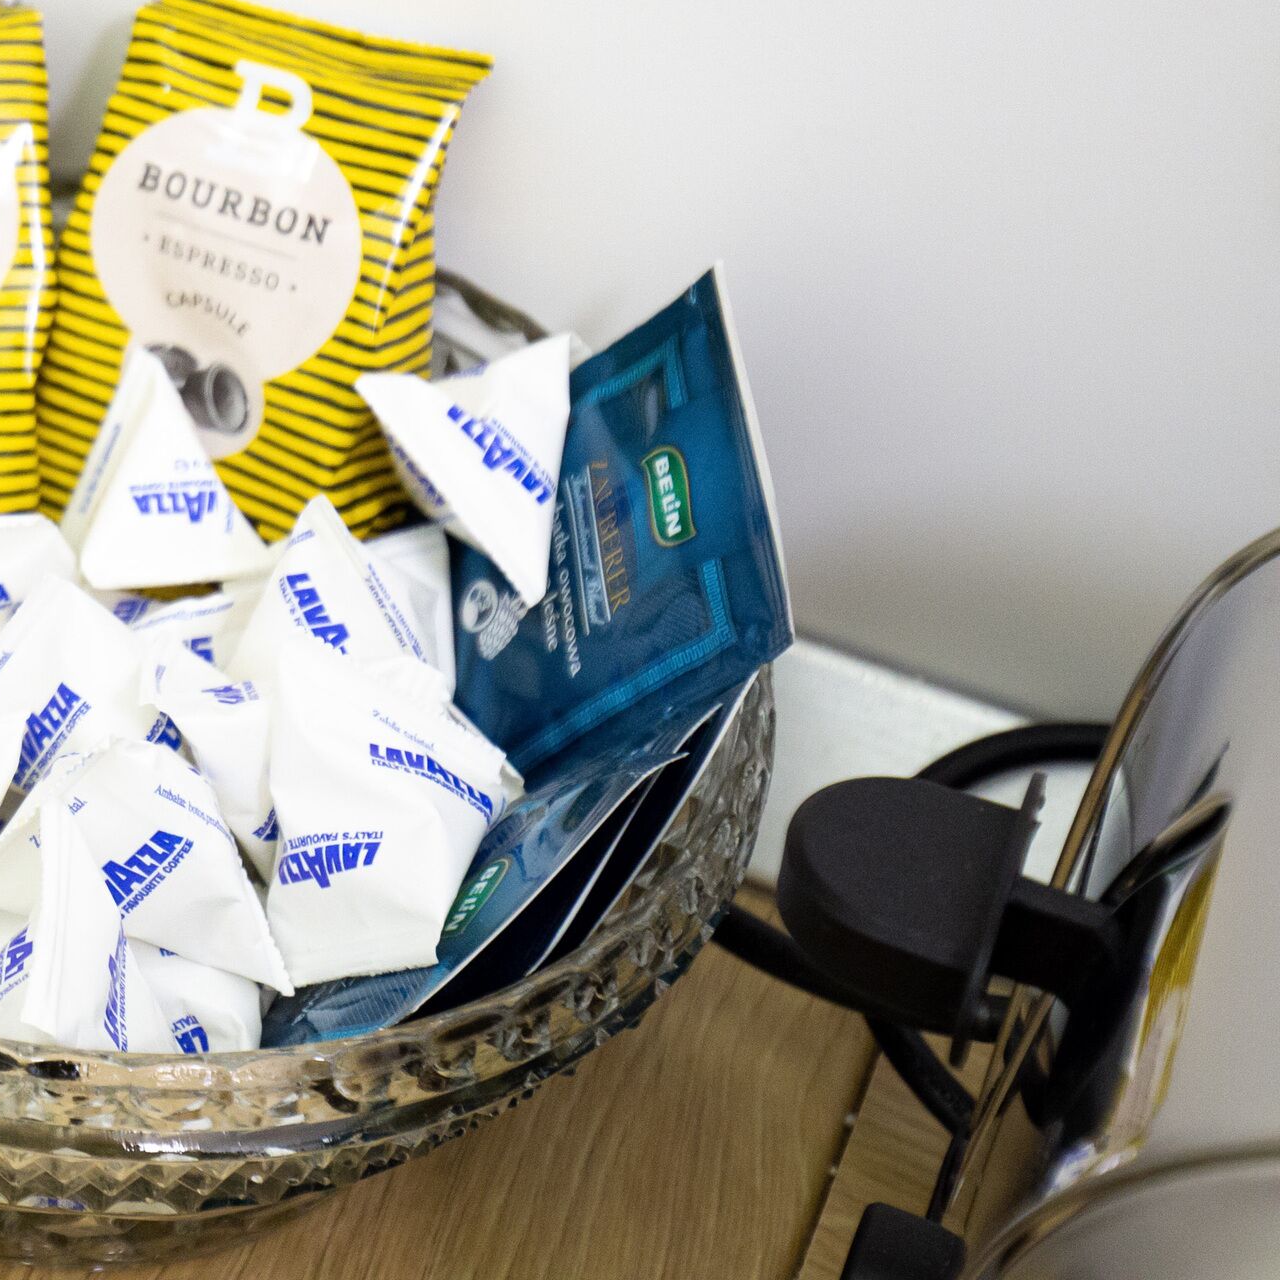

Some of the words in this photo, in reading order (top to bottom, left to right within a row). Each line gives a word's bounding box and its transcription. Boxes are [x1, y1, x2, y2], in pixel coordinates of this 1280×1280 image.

[137, 162, 332, 245] BOURBON
[158, 236, 279, 291] ESPRESSO
[165, 291, 252, 336] CAPSULE
[286, 573, 351, 655] LAVA
[122, 872, 167, 917] FAVOURITE
[162, 838, 195, 876] COFFEE
